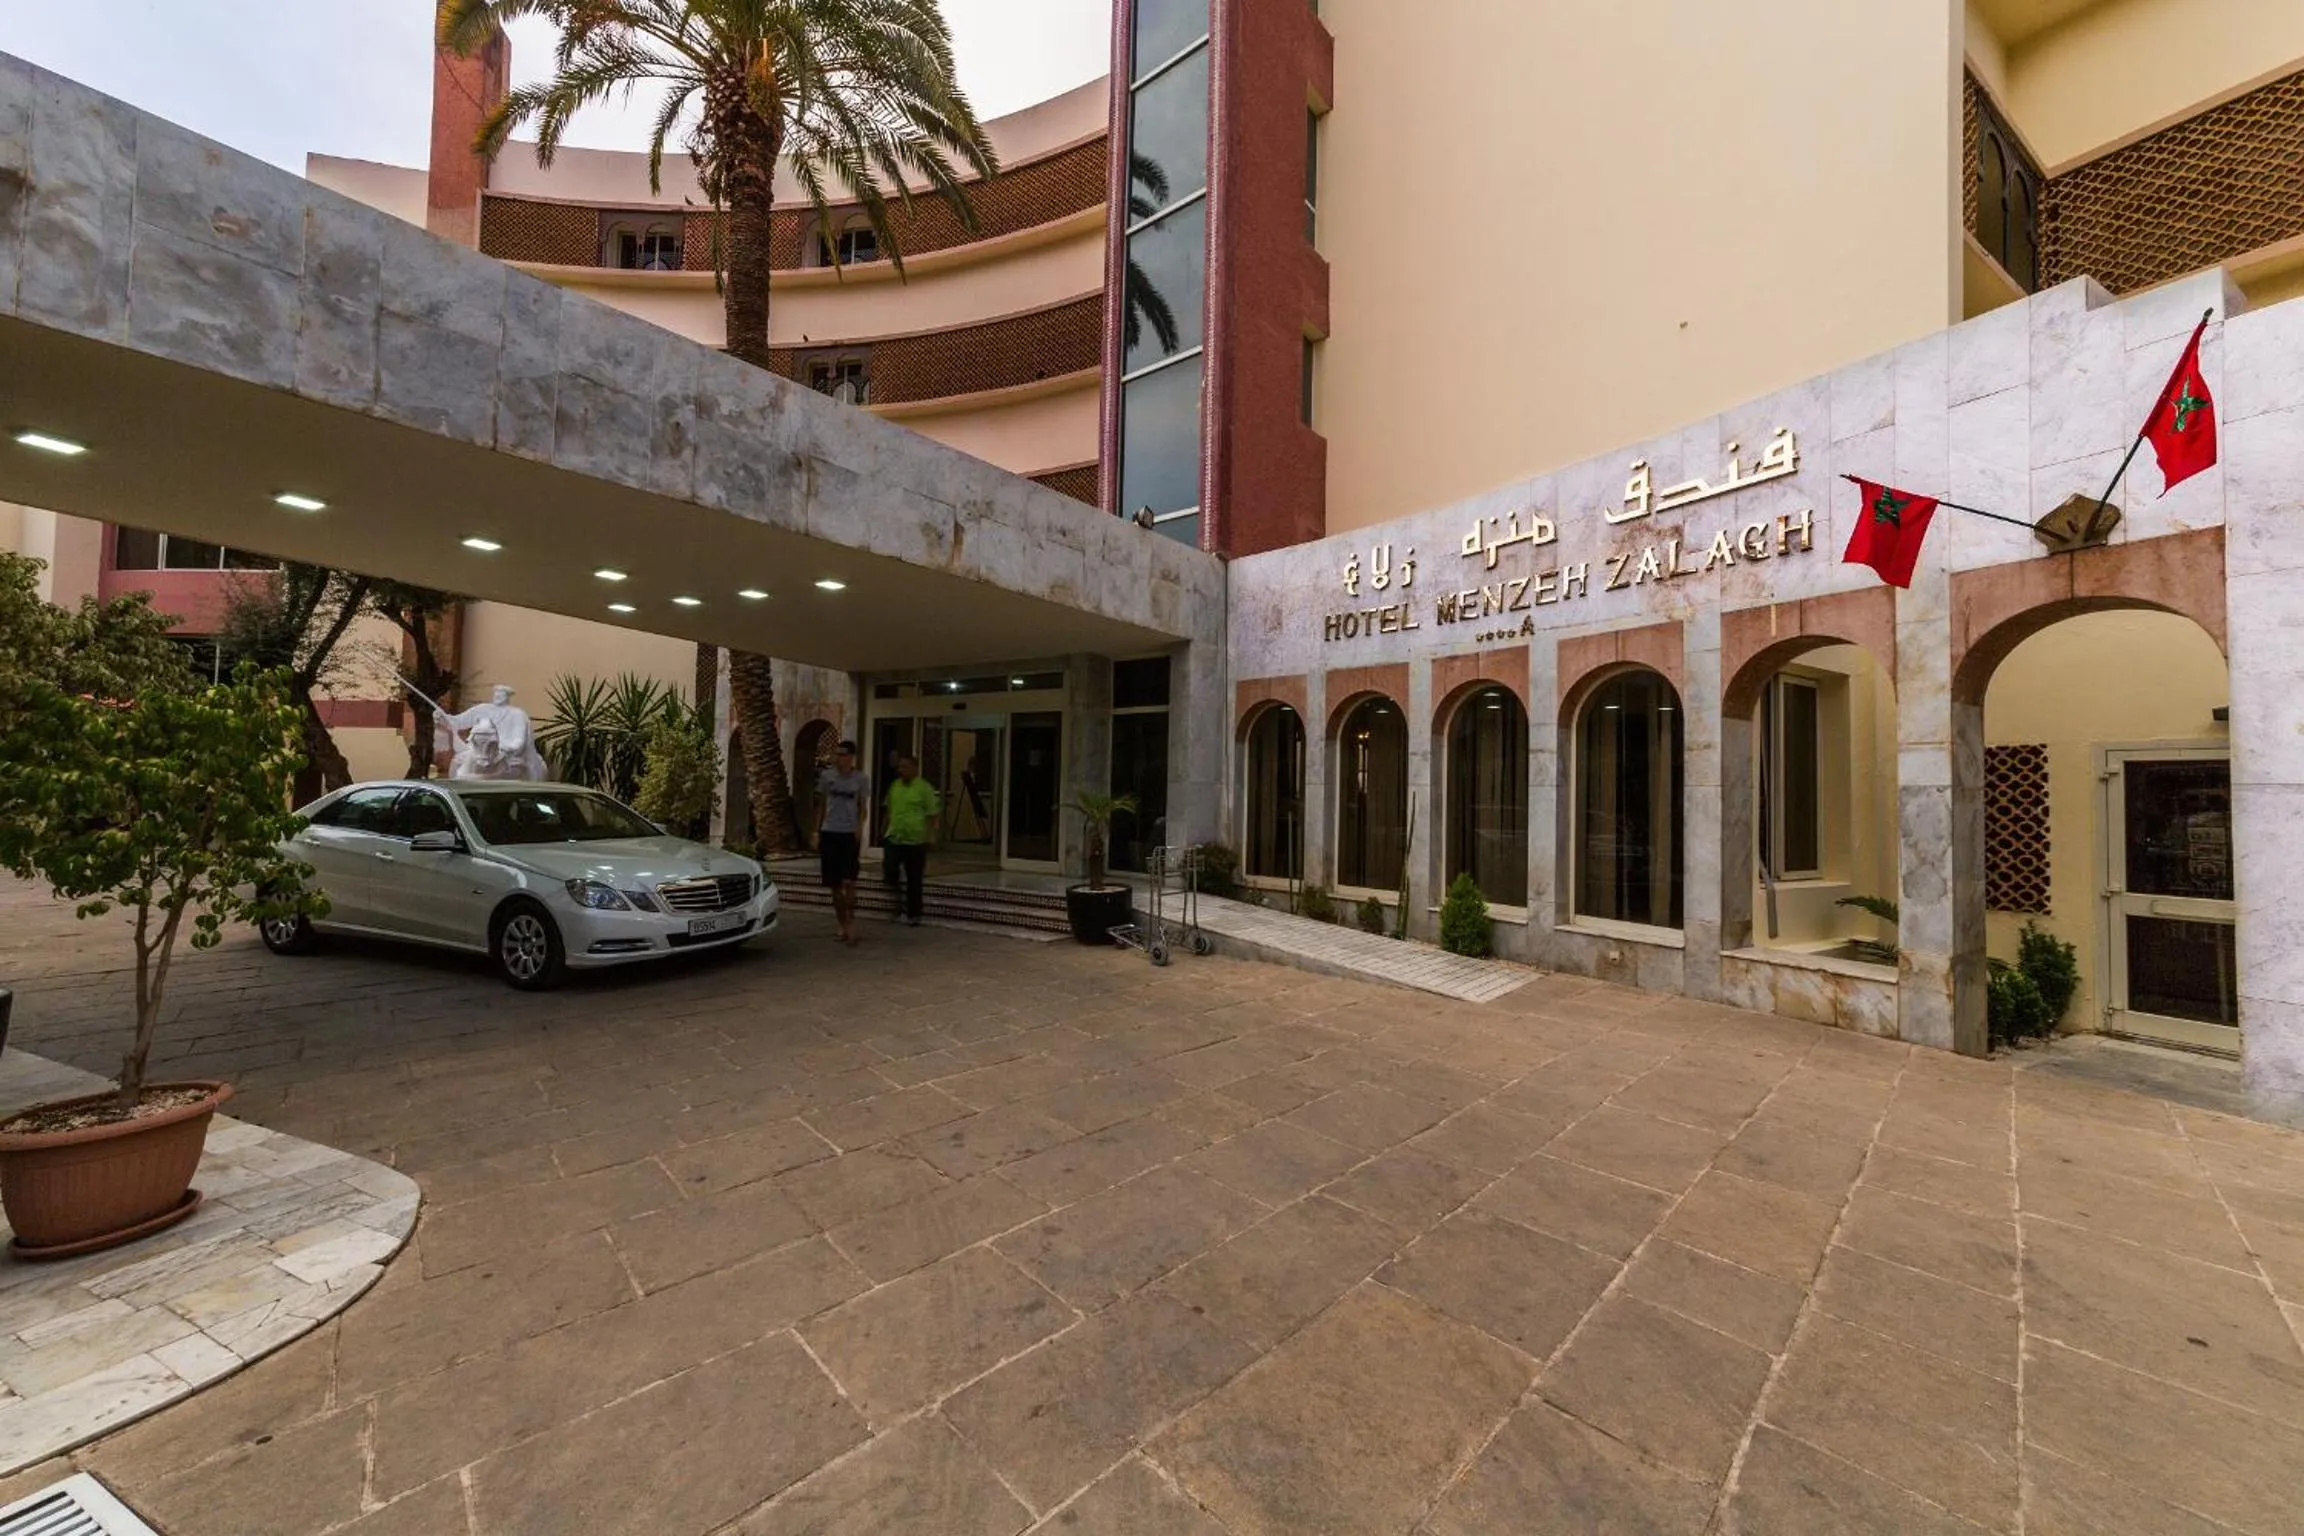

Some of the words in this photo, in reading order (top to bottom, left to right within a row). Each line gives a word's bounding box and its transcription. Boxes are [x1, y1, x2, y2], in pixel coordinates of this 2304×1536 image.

[1604, 426, 1800, 524] فندق
[1324, 602, 1420, 642] HOTEL
[1436, 562, 1589, 626] MENZEH
[1604, 509, 1814, 592] ZALAGH
[1343, 544, 1416, 597] زلاغ
[1461, 511, 1558, 571] منزه
